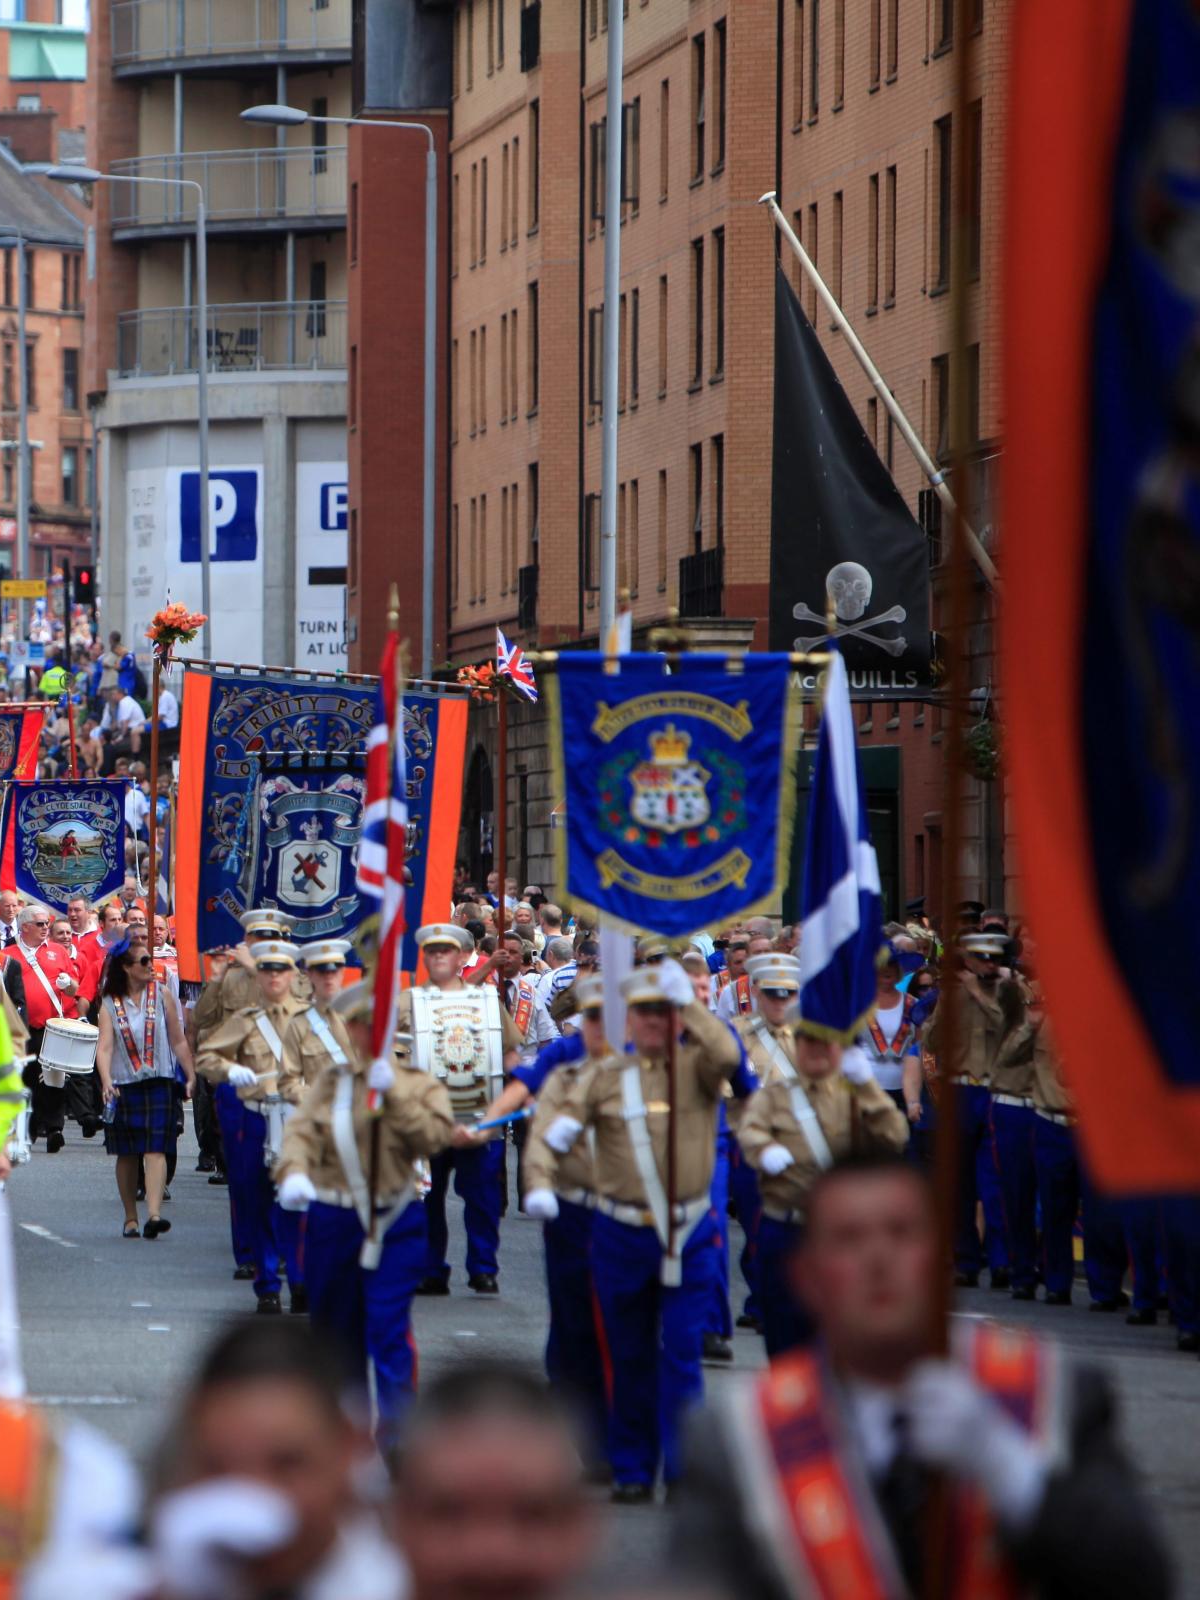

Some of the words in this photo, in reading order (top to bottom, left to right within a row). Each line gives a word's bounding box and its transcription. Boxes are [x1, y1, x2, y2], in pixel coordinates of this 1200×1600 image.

[208, 478, 238, 556] P
[299, 621, 338, 634] TURN
[307, 643, 324, 655] AT
[237, 696, 319, 739] TRINITY
[45, 802, 94, 812] CLYDESDALE
[49, 886, 66, 900] DIST
